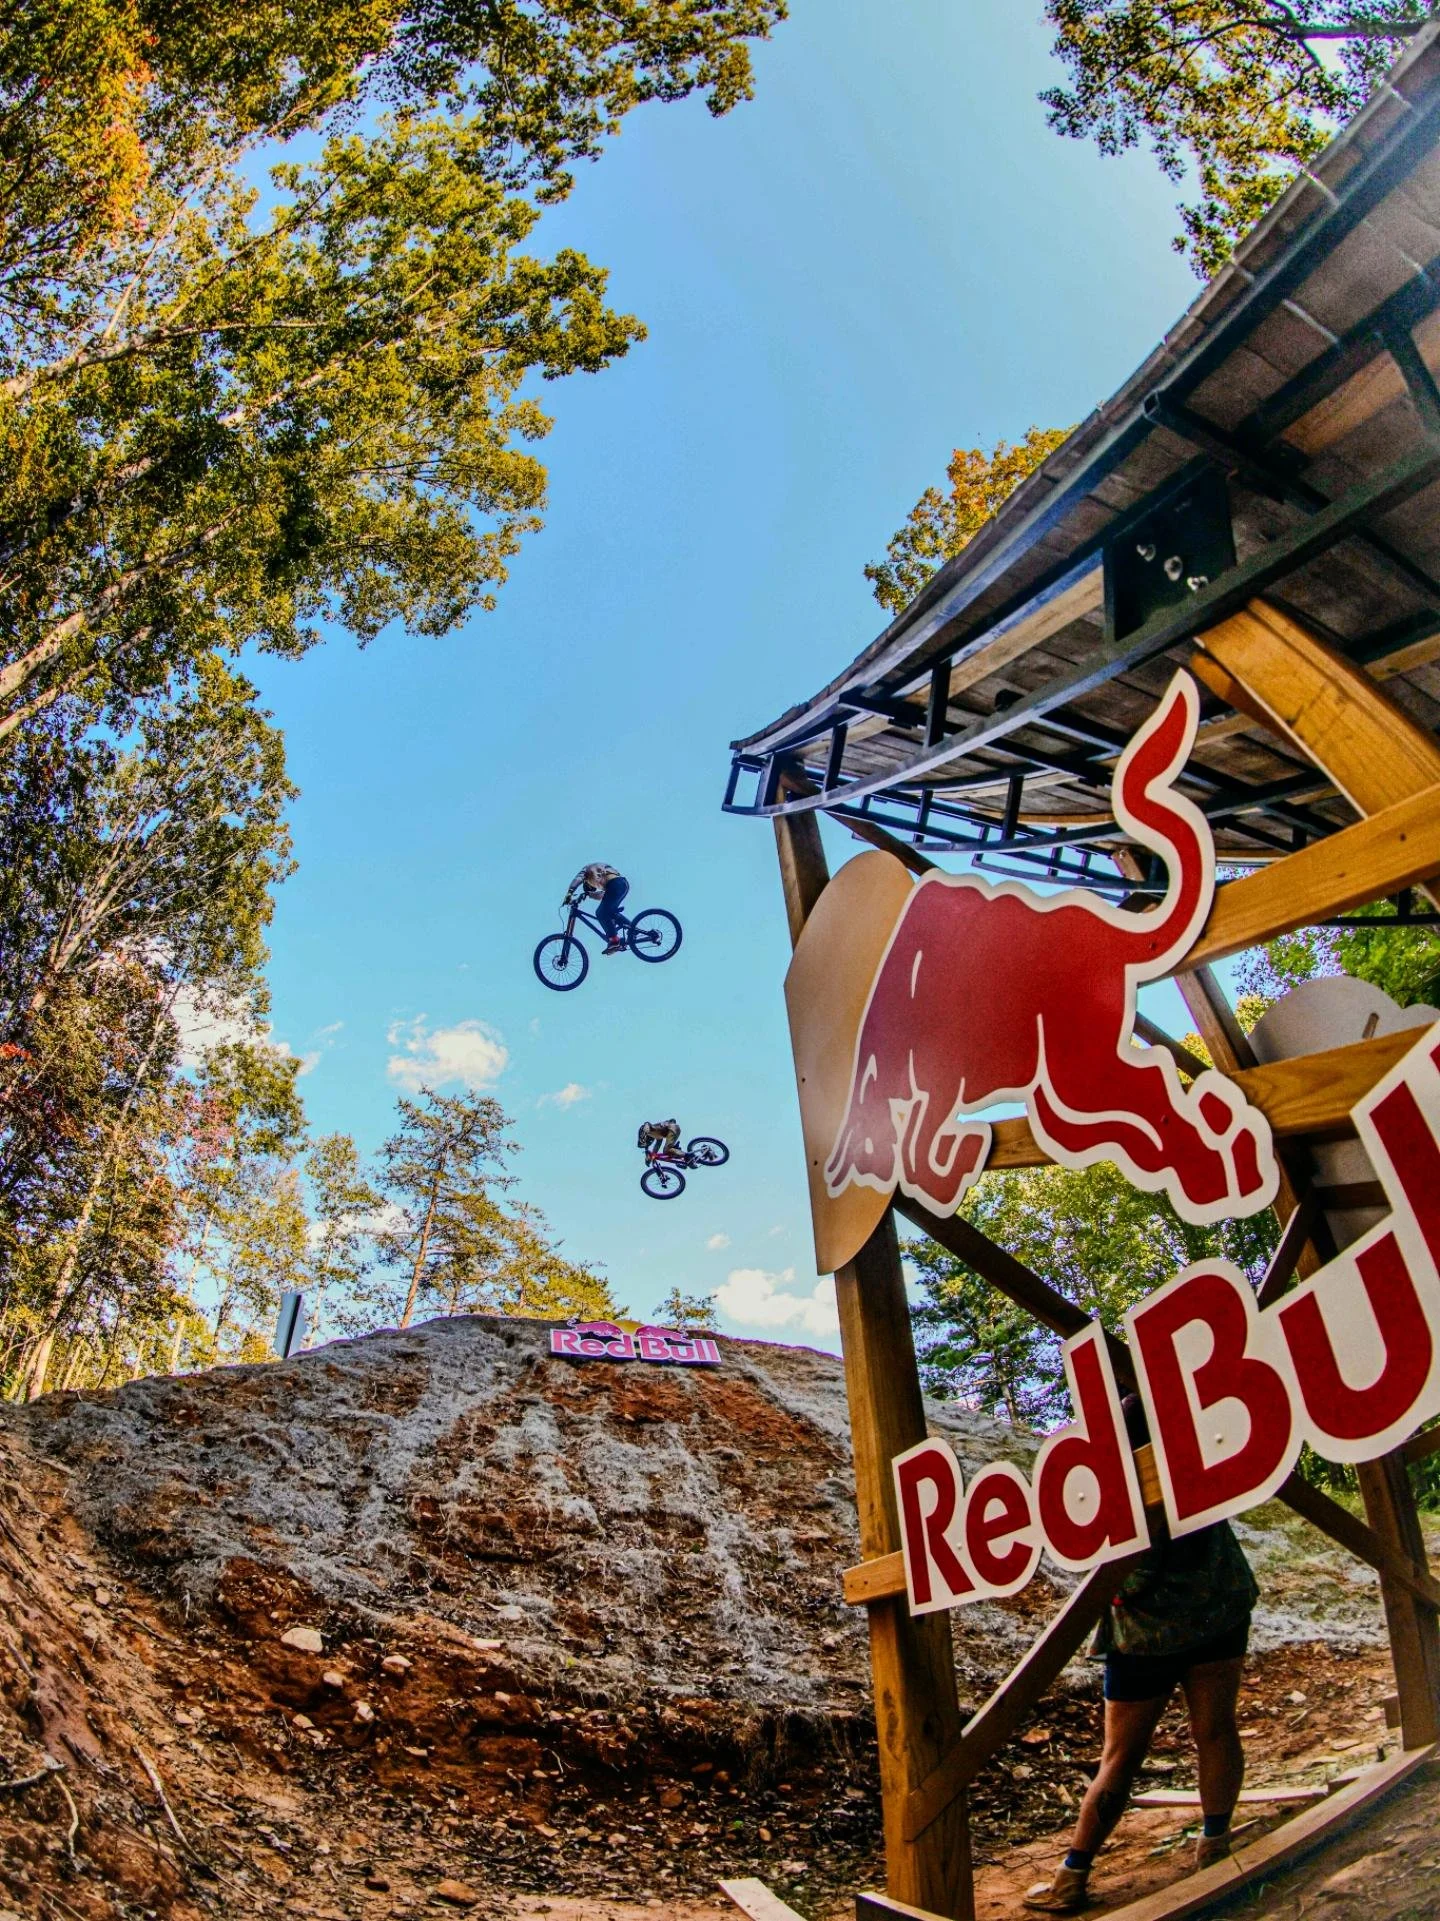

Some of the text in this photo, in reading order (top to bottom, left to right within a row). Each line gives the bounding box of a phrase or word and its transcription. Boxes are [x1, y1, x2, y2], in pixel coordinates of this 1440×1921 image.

[552, 1330, 720, 1361] Red Bull
[897, 1041, 1440, 1604] Red Bu
